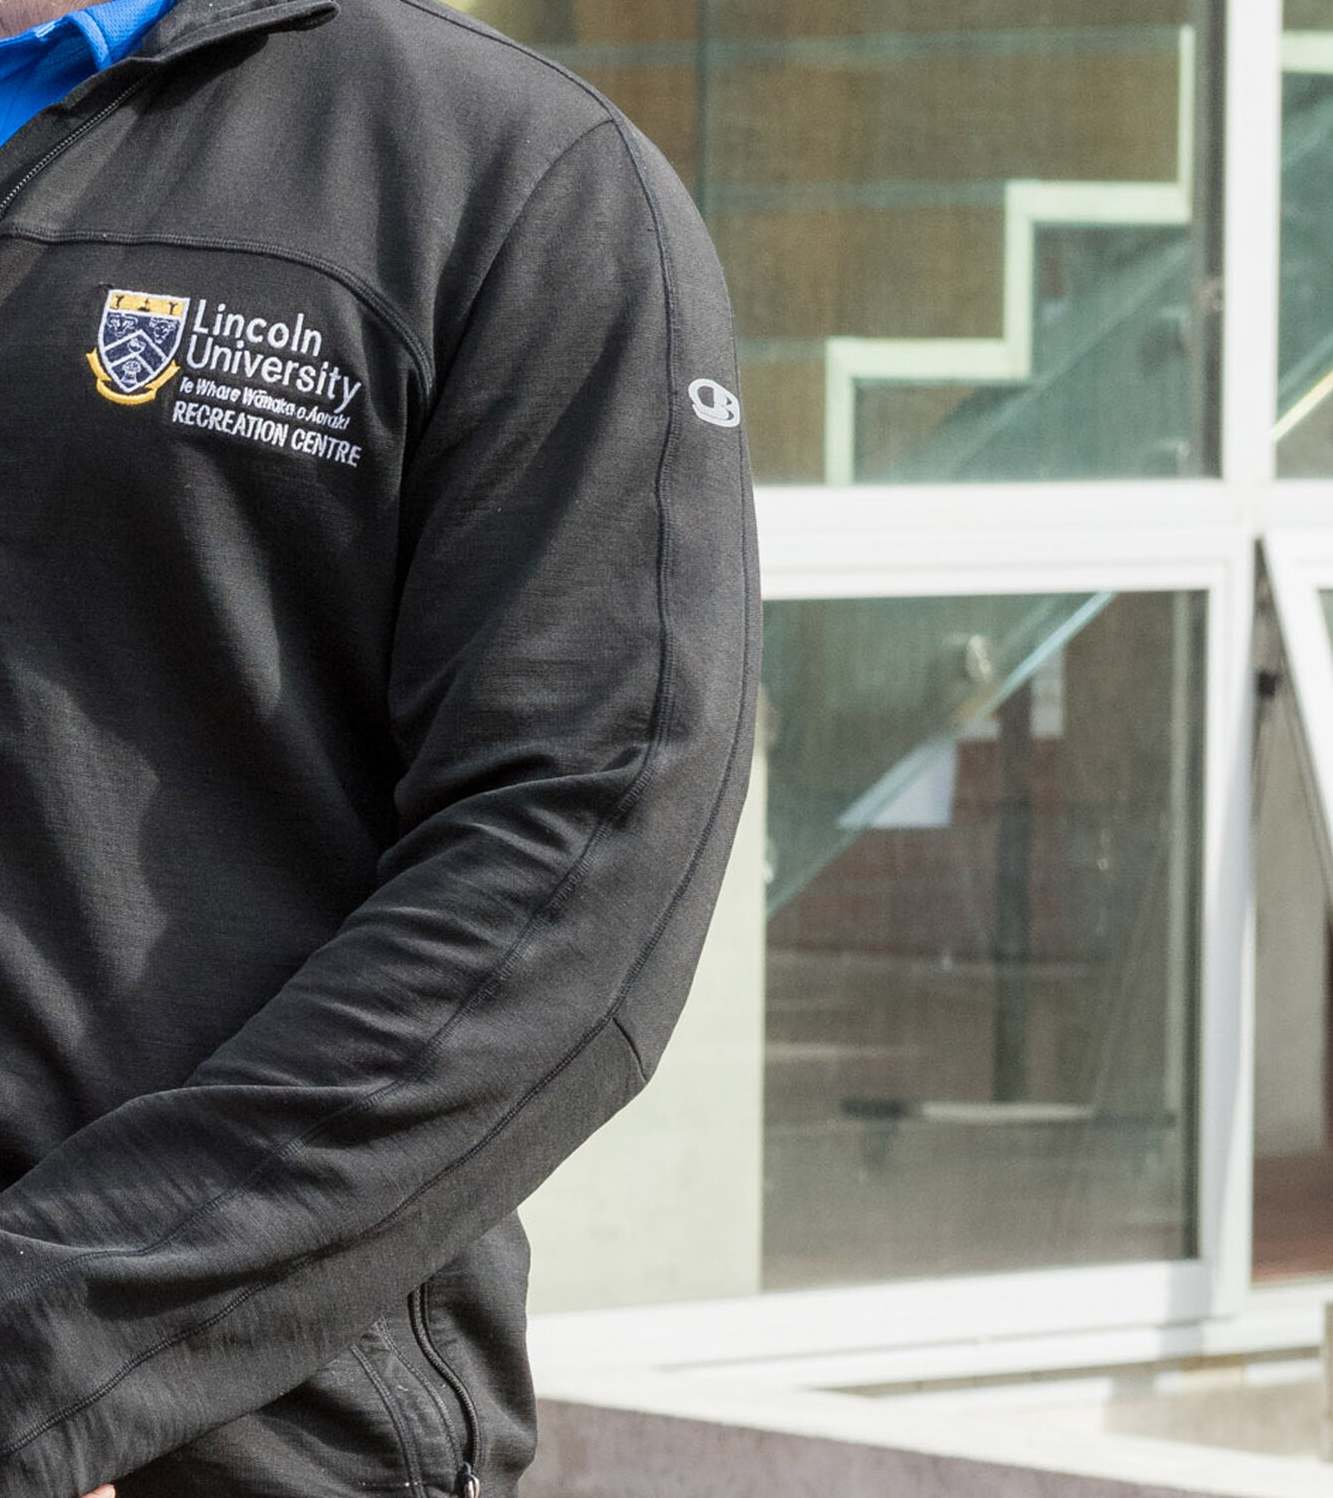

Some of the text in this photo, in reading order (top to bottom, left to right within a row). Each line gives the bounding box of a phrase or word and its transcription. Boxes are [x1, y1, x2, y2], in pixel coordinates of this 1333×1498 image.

[192, 298, 322, 357] Lincoln
[179, 376, 194, 394] Te
[195, 378, 241, 402] Whare
[186, 333, 362, 414] University
[172, 400, 362, 467] RECREATION CENTRE
